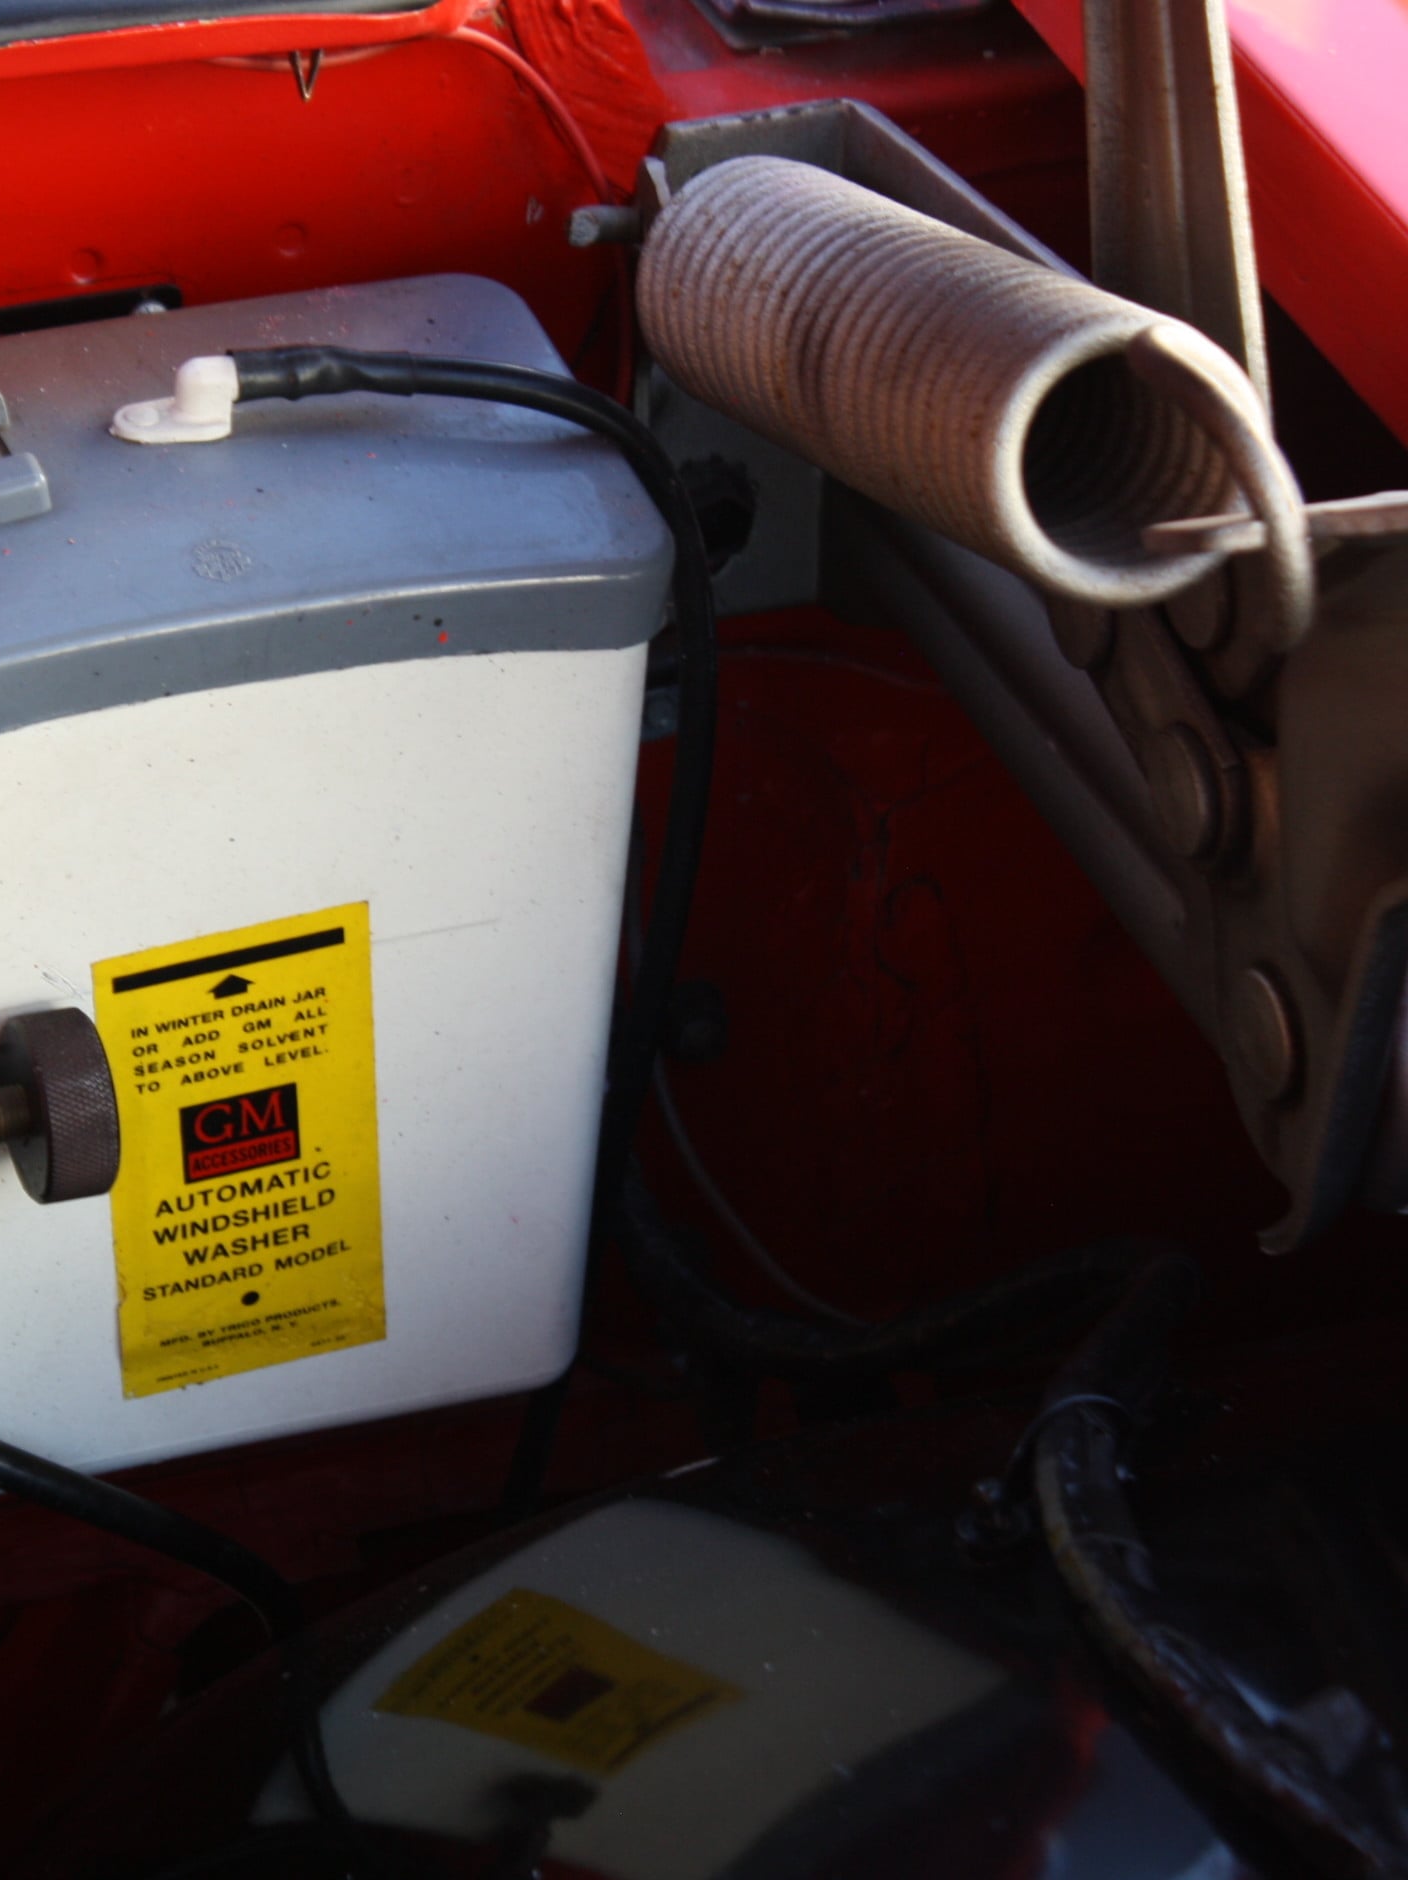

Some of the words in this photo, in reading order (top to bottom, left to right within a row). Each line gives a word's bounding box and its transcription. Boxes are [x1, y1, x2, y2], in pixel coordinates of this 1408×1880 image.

[131, 1026, 149, 1039] IN
[155, 1010, 225, 1034] WINTER
[231, 996, 286, 1018] DRAIN
[292, 987, 326, 1005] JAR
[132, 1043, 159, 1058] OR
[182, 1030, 221, 1048] ADD
[242, 1018, 272, 1034] GM
[294, 1007, 327, 1023] ALL
[134, 1050, 216, 1077] SEASON
[238, 1024, 328, 1054] SOLVENT
[136, 1081, 161, 1096] TO
[180, 1062, 245, 1086] ABOVE
[264, 1044, 329, 1067] LEVEL.
[194, 1090, 286, 1144] GM
[192, 1138, 291, 1171] ACCESSORIES
[155, 1161, 332, 1218] AUTOMATIC
[153, 1188, 336, 1246] WINDSHIELD
[142, 1263, 263, 1301] STANDARD
[274, 1239, 352, 1272] MODEL
[183, 1223, 310, 1267] WASHER
[197, 1327, 215, 1339] BY
